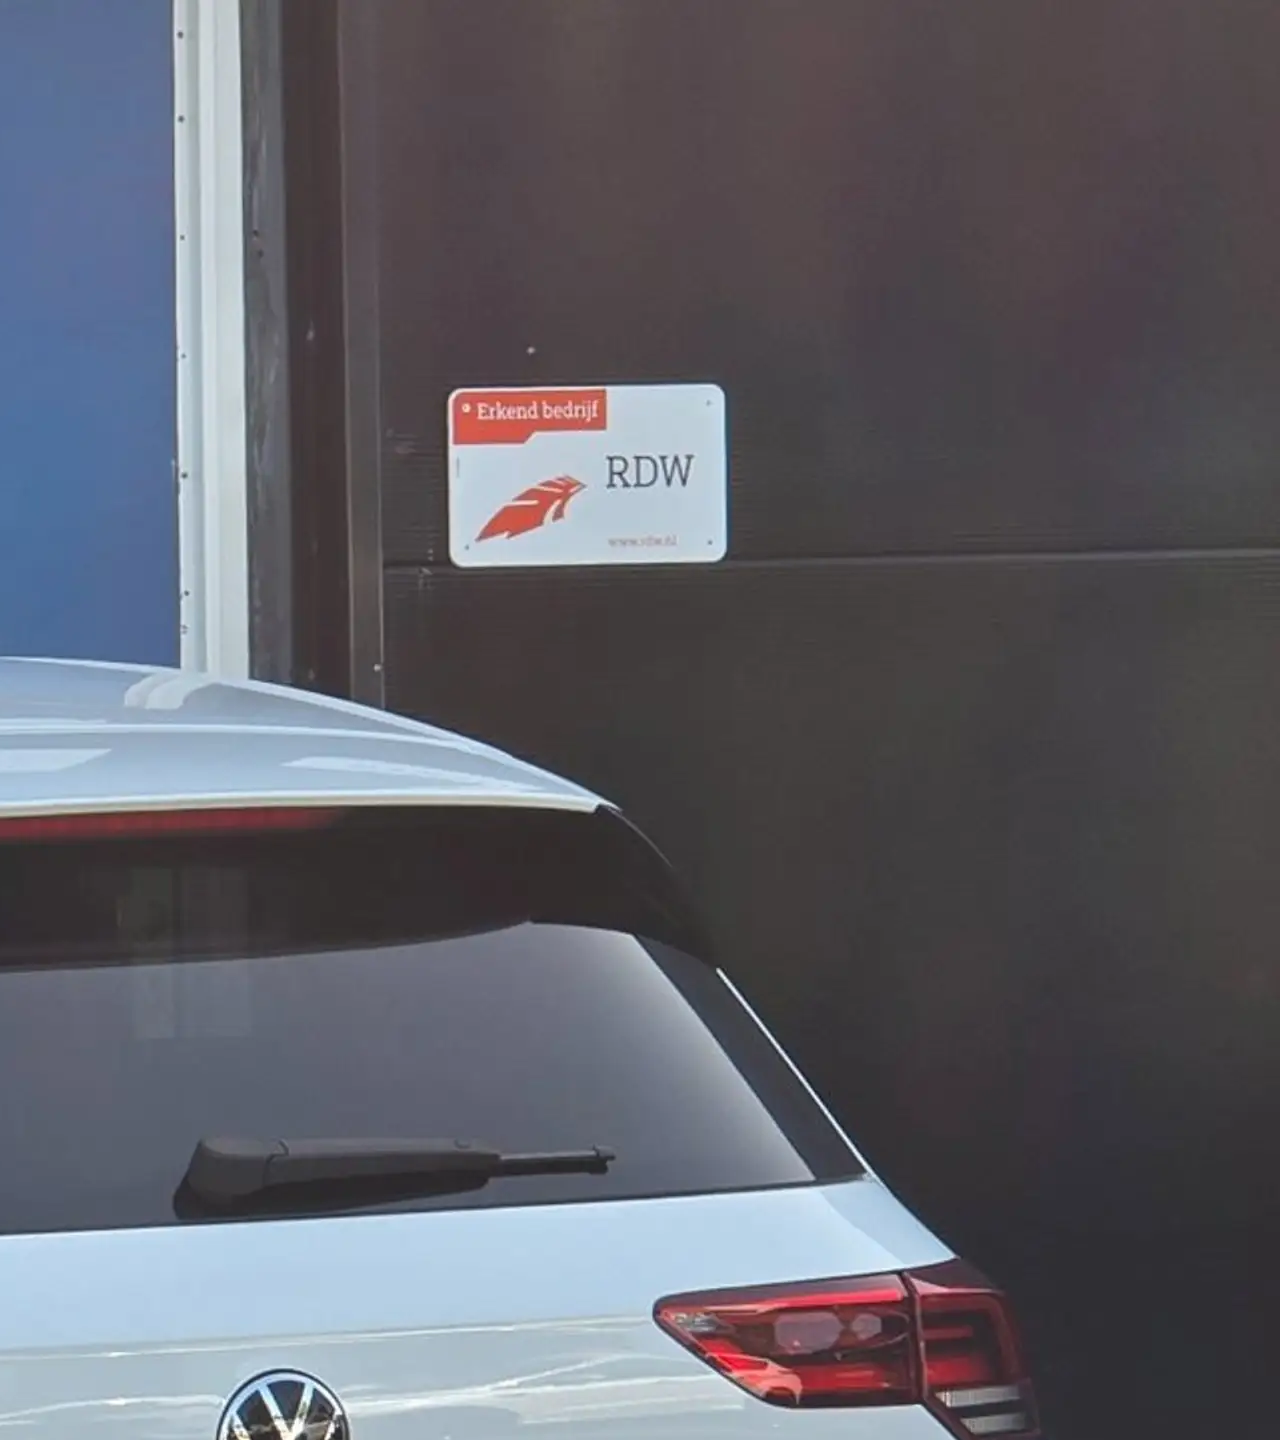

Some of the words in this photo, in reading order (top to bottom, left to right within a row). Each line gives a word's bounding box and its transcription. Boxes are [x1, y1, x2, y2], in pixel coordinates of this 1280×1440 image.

[477, 401, 538, 420] Erkend
[542, 400, 600, 422] bedrijf
[606, 454, 694, 489] RDW
